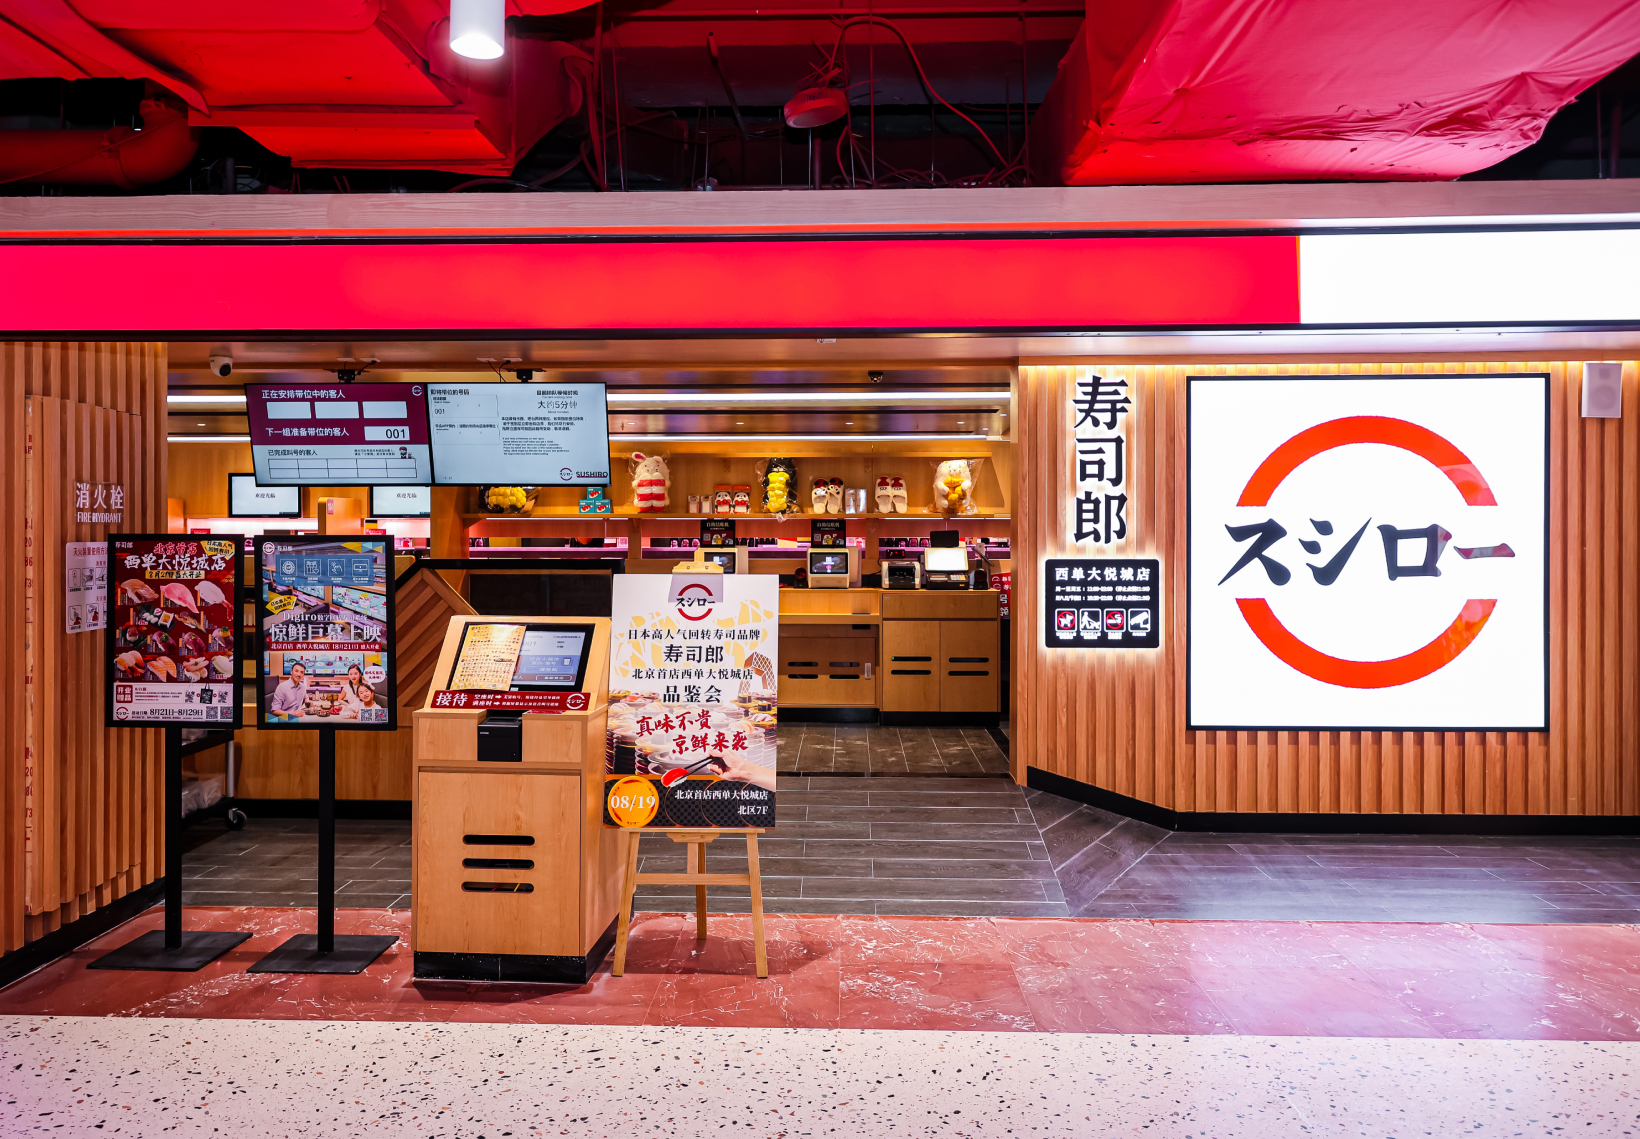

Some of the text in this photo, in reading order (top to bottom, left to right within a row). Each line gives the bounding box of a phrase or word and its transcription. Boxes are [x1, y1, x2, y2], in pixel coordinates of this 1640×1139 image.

[262, 389, 345, 399] 正在安排带位中的客人
[537, 400, 578, 409] 大约5分钟
[265, 427, 349, 437] 下一组准备带位的客人
[385, 429, 406, 439] 001
[1072, 375, 1132, 544] 寿司郎
[76, 482, 124, 509] 消火栓
[77, 511, 122, 523] FIRE HYDRANT
[1218, 517, 1516, 586] スシロー
[124, 552, 226, 571] 西单大悦城店
[1055, 567, 1151, 581] 西单大悦城店
[675, 597, 716, 607] スシロー
[282, 612, 317, 622] Digiro
[269, 623, 382, 642] 惊鲜巨幕上映
[628, 629, 761, 640] 日本高人气回转寿司品牌
[663, 643, 724, 664] 寿司郎
[632, 668, 754, 680] 北京首店西单大悦城店
[435, 692, 468, 707] 接待
[662, 685, 722, 703] 品鉴会
[674, 790, 769, 800] 北京首店西单大悦城店
[610, 795, 656, 811] 08/19
[737, 805, 769, 815] 北区7F
